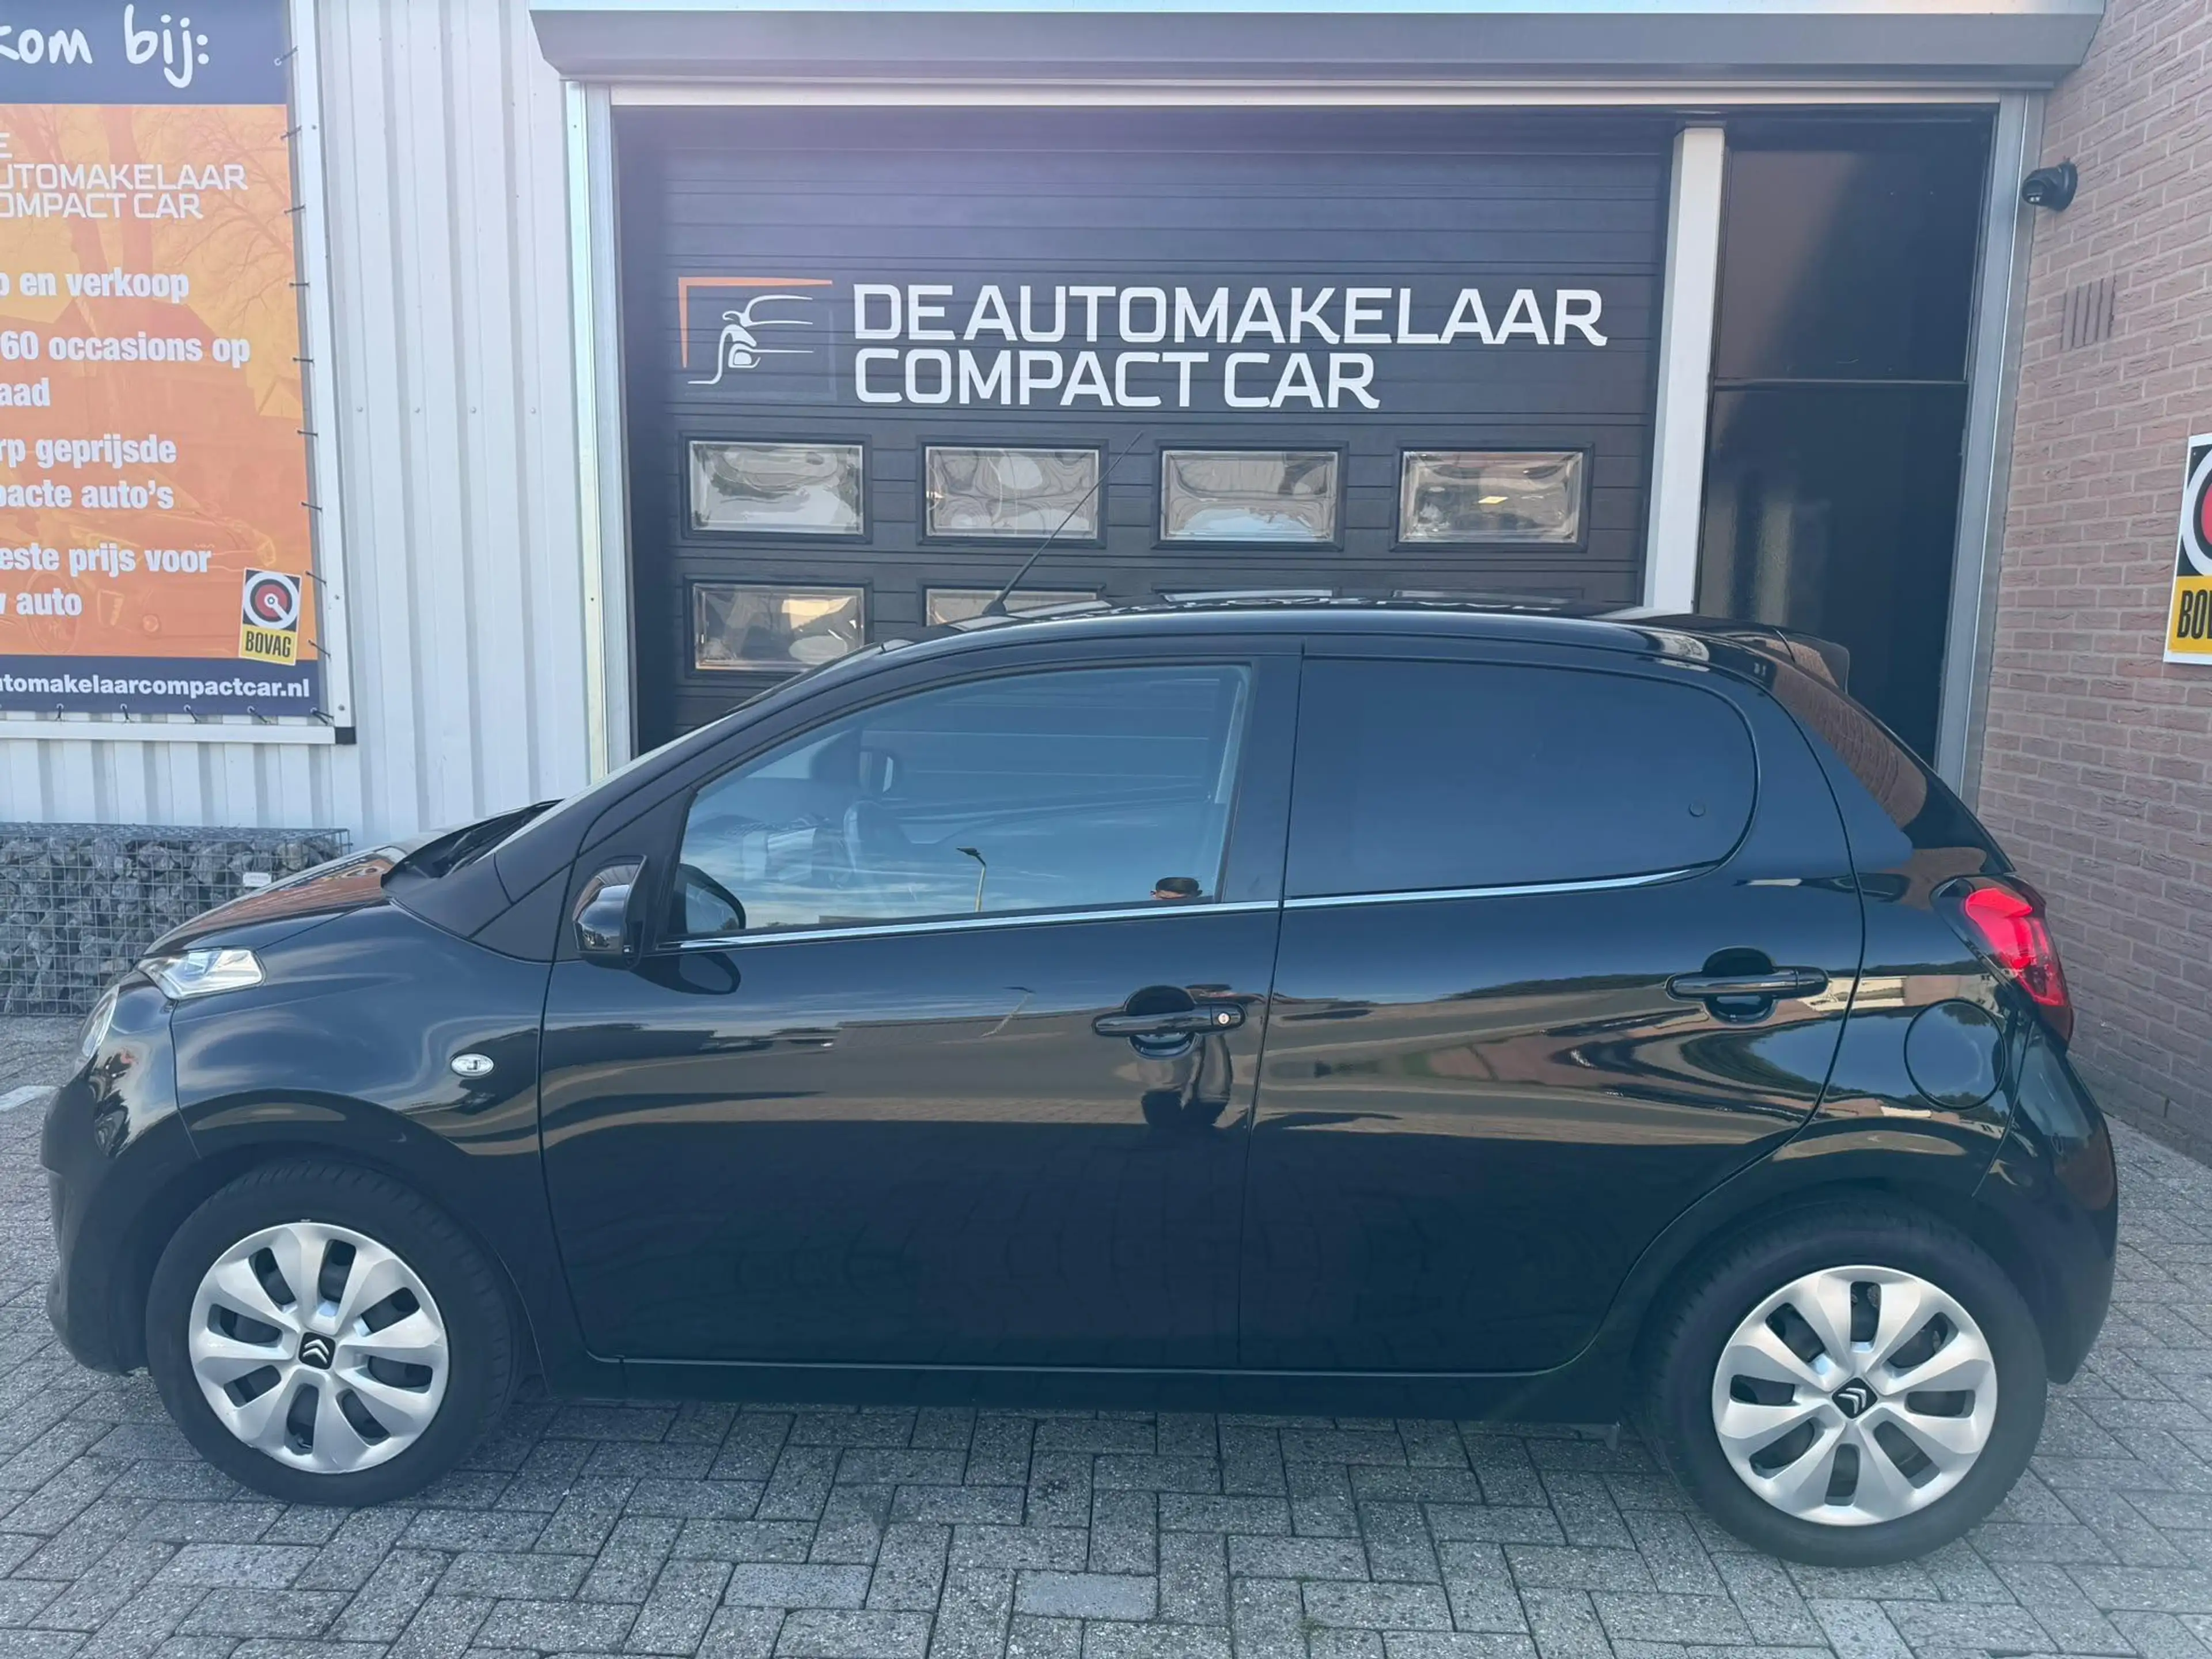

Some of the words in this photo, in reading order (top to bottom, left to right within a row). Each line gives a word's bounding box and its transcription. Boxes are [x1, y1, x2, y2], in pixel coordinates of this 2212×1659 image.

[124, 3, 209, 88] bij:
[134, 193, 203, 219] CAR
[20, 272, 57, 296] en
[65, 267, 190, 304] verkoop
[854, 284, 955, 340] DE
[962, 286, 1608, 346] AUTOMAKELAAR
[1, 331, 39, 360] 60
[48, 332, 203, 362] occasions
[212, 338, 251, 368] op
[855, 349, 1209, 407] COMPACT
[1224, 352, 1380, 409] CAR
[35, 433, 177, 469] geprijsde
[0, 542, 60, 571] este
[69, 543, 136, 578] prijs
[144, 550, 213, 573] voor
[16, 588, 82, 616] auto
[2176, 589, 2212, 639] BO
[245, 631, 291, 657] BOVAG
[0, 674, 310, 699] tomakelaarcompactcar.nl
